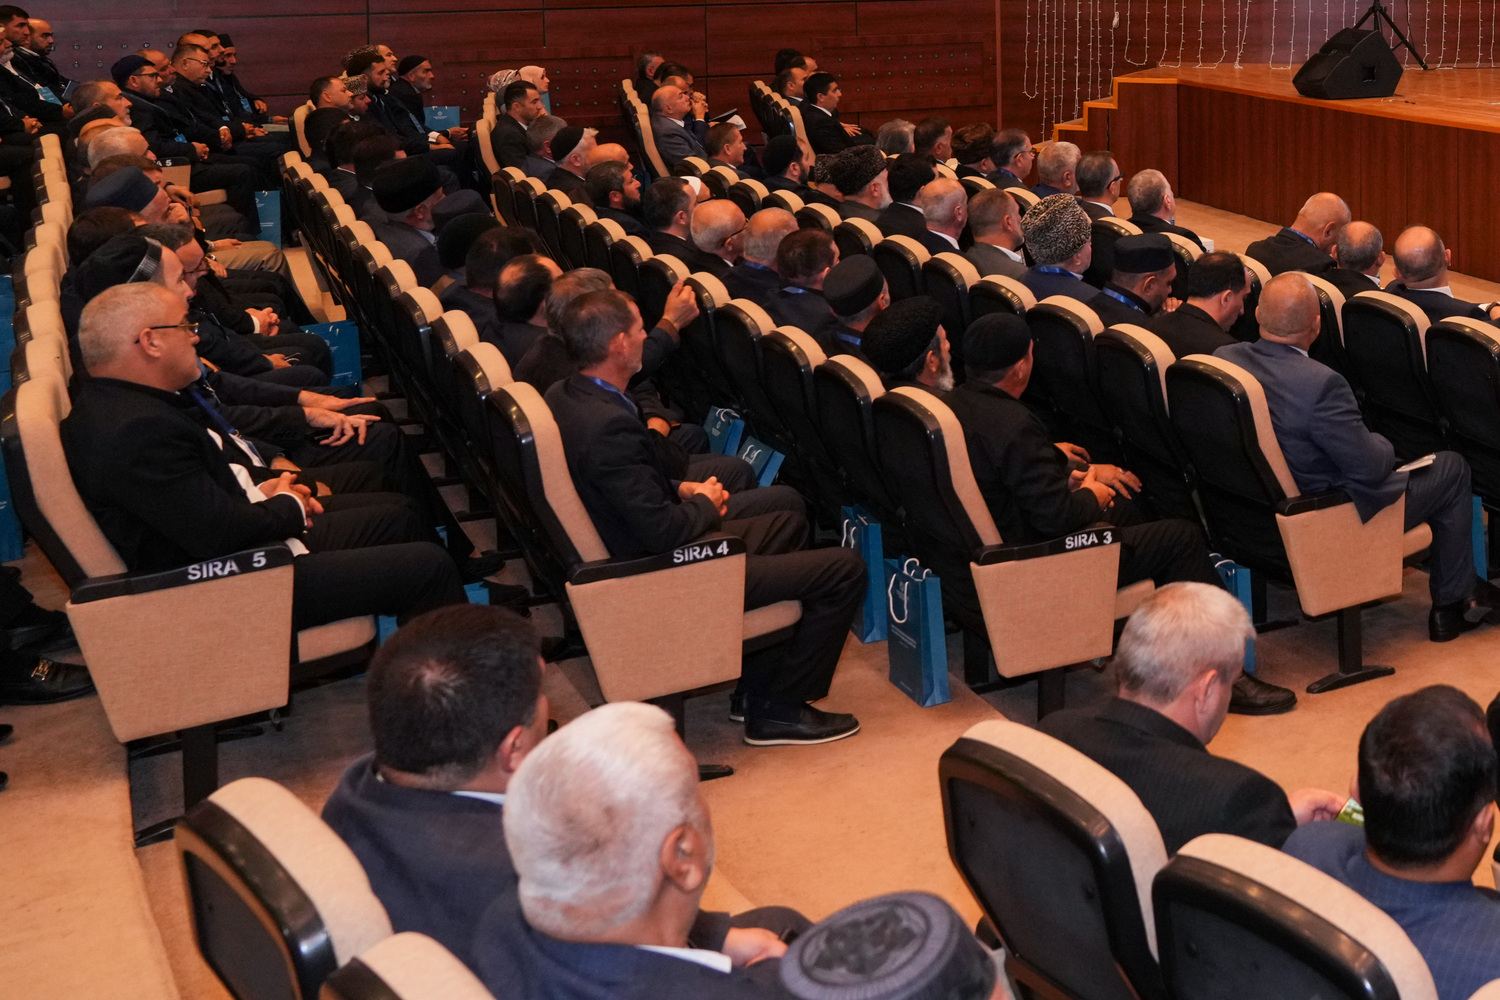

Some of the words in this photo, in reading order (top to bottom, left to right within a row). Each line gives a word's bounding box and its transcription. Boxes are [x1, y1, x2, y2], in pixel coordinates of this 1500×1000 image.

[165, 159, 172, 167] 5
[1065, 532, 1099, 549] SIRA
[1103, 531, 1113, 545] 3
[673, 545, 713, 563] SIRA
[717, 540, 729, 555] 4
[187, 559, 240, 580] SIRA
[252, 551, 267, 568] 5
